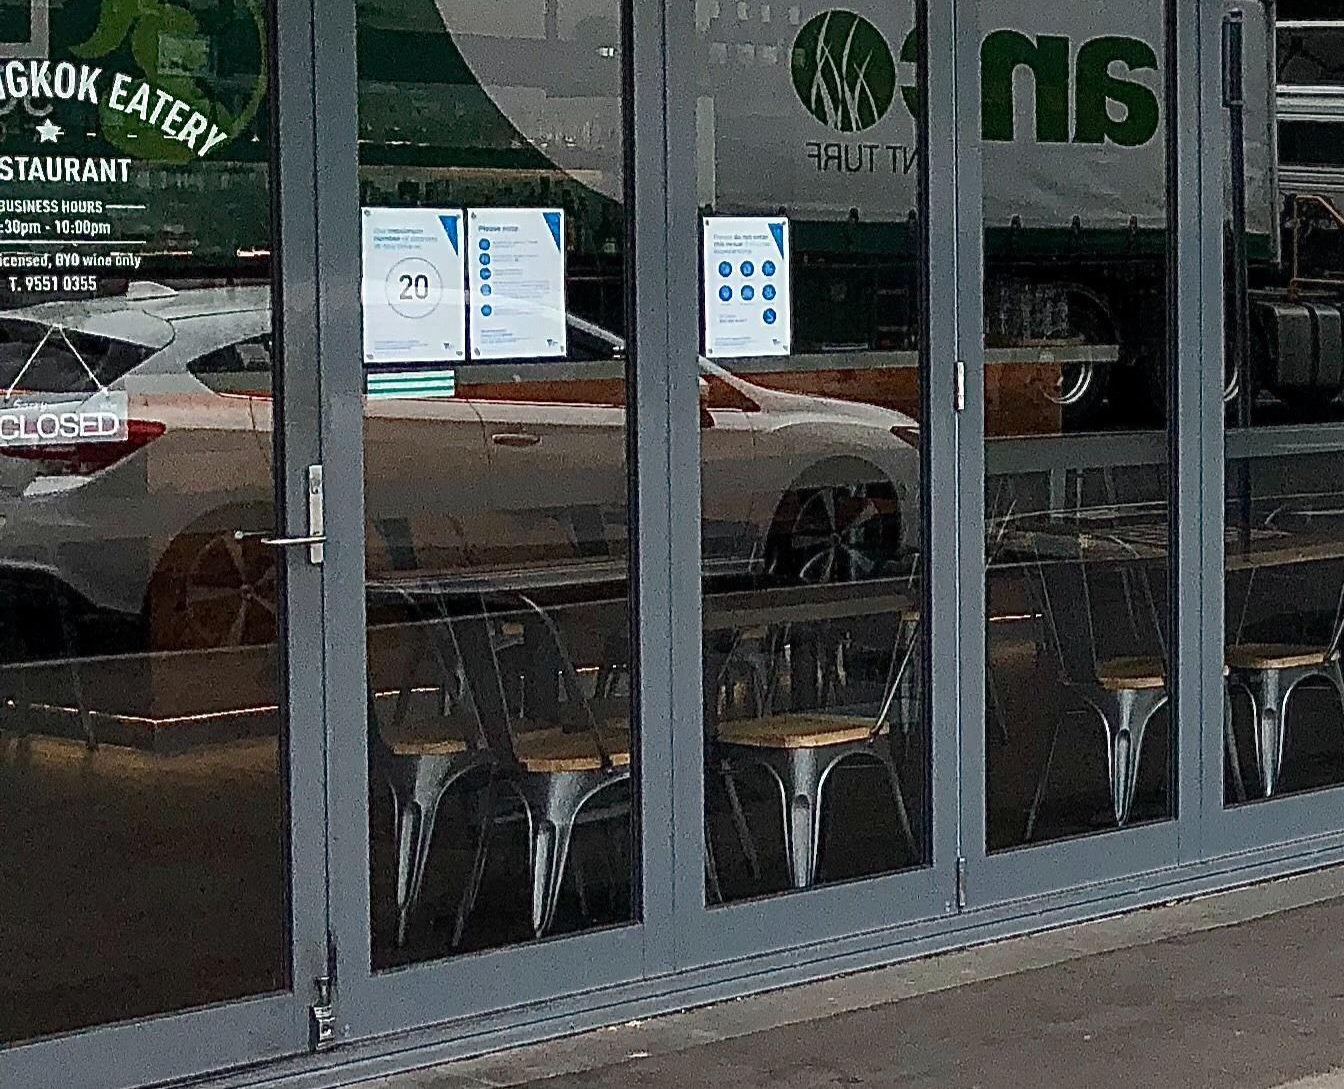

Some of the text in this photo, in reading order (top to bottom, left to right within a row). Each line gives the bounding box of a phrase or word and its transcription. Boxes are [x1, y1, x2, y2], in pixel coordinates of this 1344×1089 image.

[109, 72, 228, 157] EATERY
[0, 199, 103, 214] BUSINESS HOURS
[54, 220, 111, 236] 10:00pm
[82, 254, 112, 266] wine
[115, 252, 142, 269] only
[8, 276, 97, 292] T. 9551 0355
[399, 274, 429, 300] 20
[0, 411, 120, 440] CLOSED
